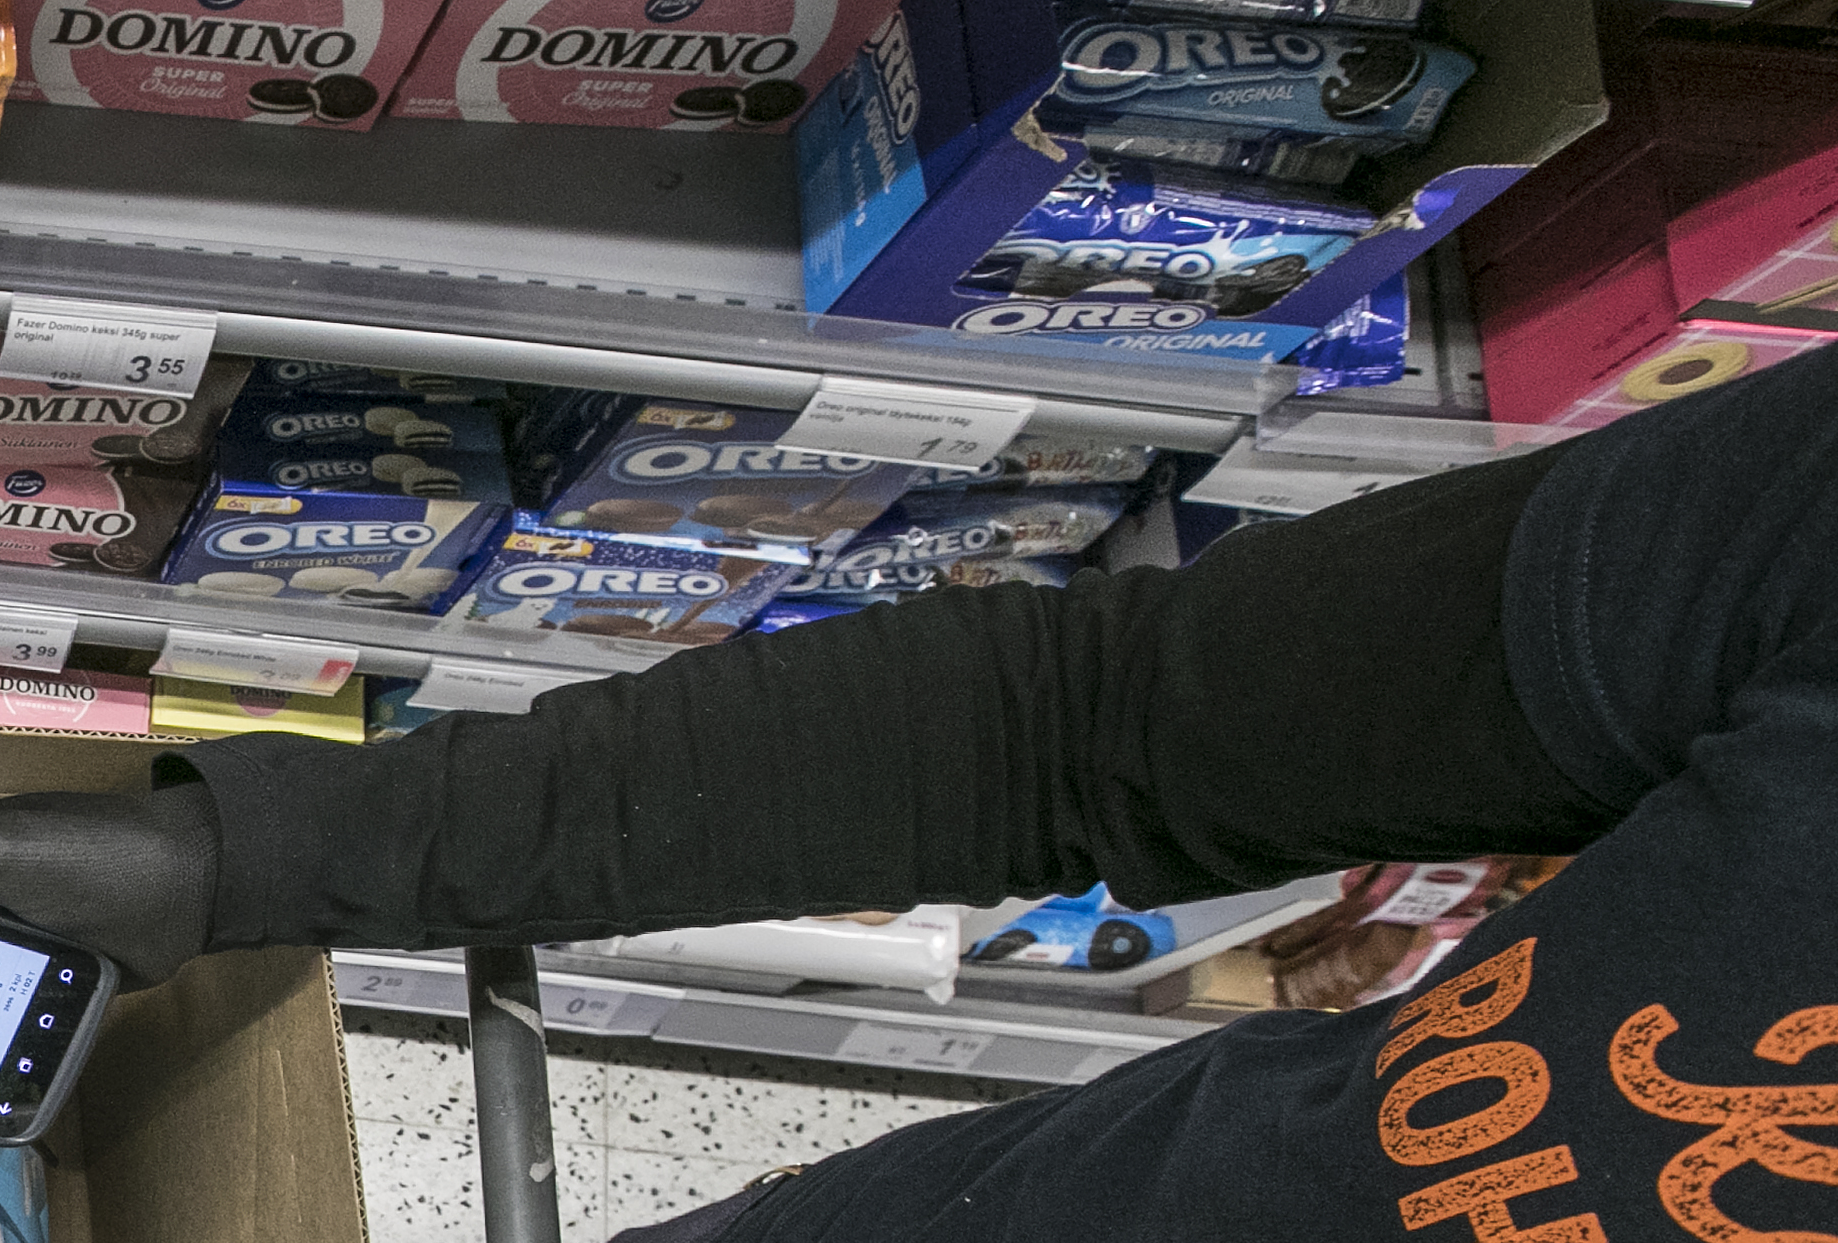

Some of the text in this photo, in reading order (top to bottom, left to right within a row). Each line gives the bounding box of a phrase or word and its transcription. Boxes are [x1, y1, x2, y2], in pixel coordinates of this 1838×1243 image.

[50, 9, 356, 68] DOMINO
[481, 27, 798, 75] DOMINO
[1071, 27, 1325, 88] OREO
[152, 67, 225, 82] SUPER
[140, 78, 225, 99] Original
[580, 80, 653, 93] SUPER
[1208, 85, 1293, 107] ORIGINAL
[963, 305, 1202, 334] OREO
[14, 330, 54, 344] original
[17, 318, 46, 330] Fazer
[49, 321, 89, 334] Domino
[91, 325, 120, 337] keksi
[150, 331, 181, 344] super
[1103, 331, 1266, 351] ORIGINAL
[125, 355, 185, 383] 3 55
[271, 414, 361, 439] OREO
[7, 475, 43, 490] Fazer
[278, 461, 368, 485] OREO
[227, 499, 247, 510] 6x
[218, 523, 434, 561] OREO
[498, 570, 721, 597] OREO
[13, 643, 57, 661] 3 99
[12, 973, 22, 986] kpl
[23, 977, 32, 987] 02
